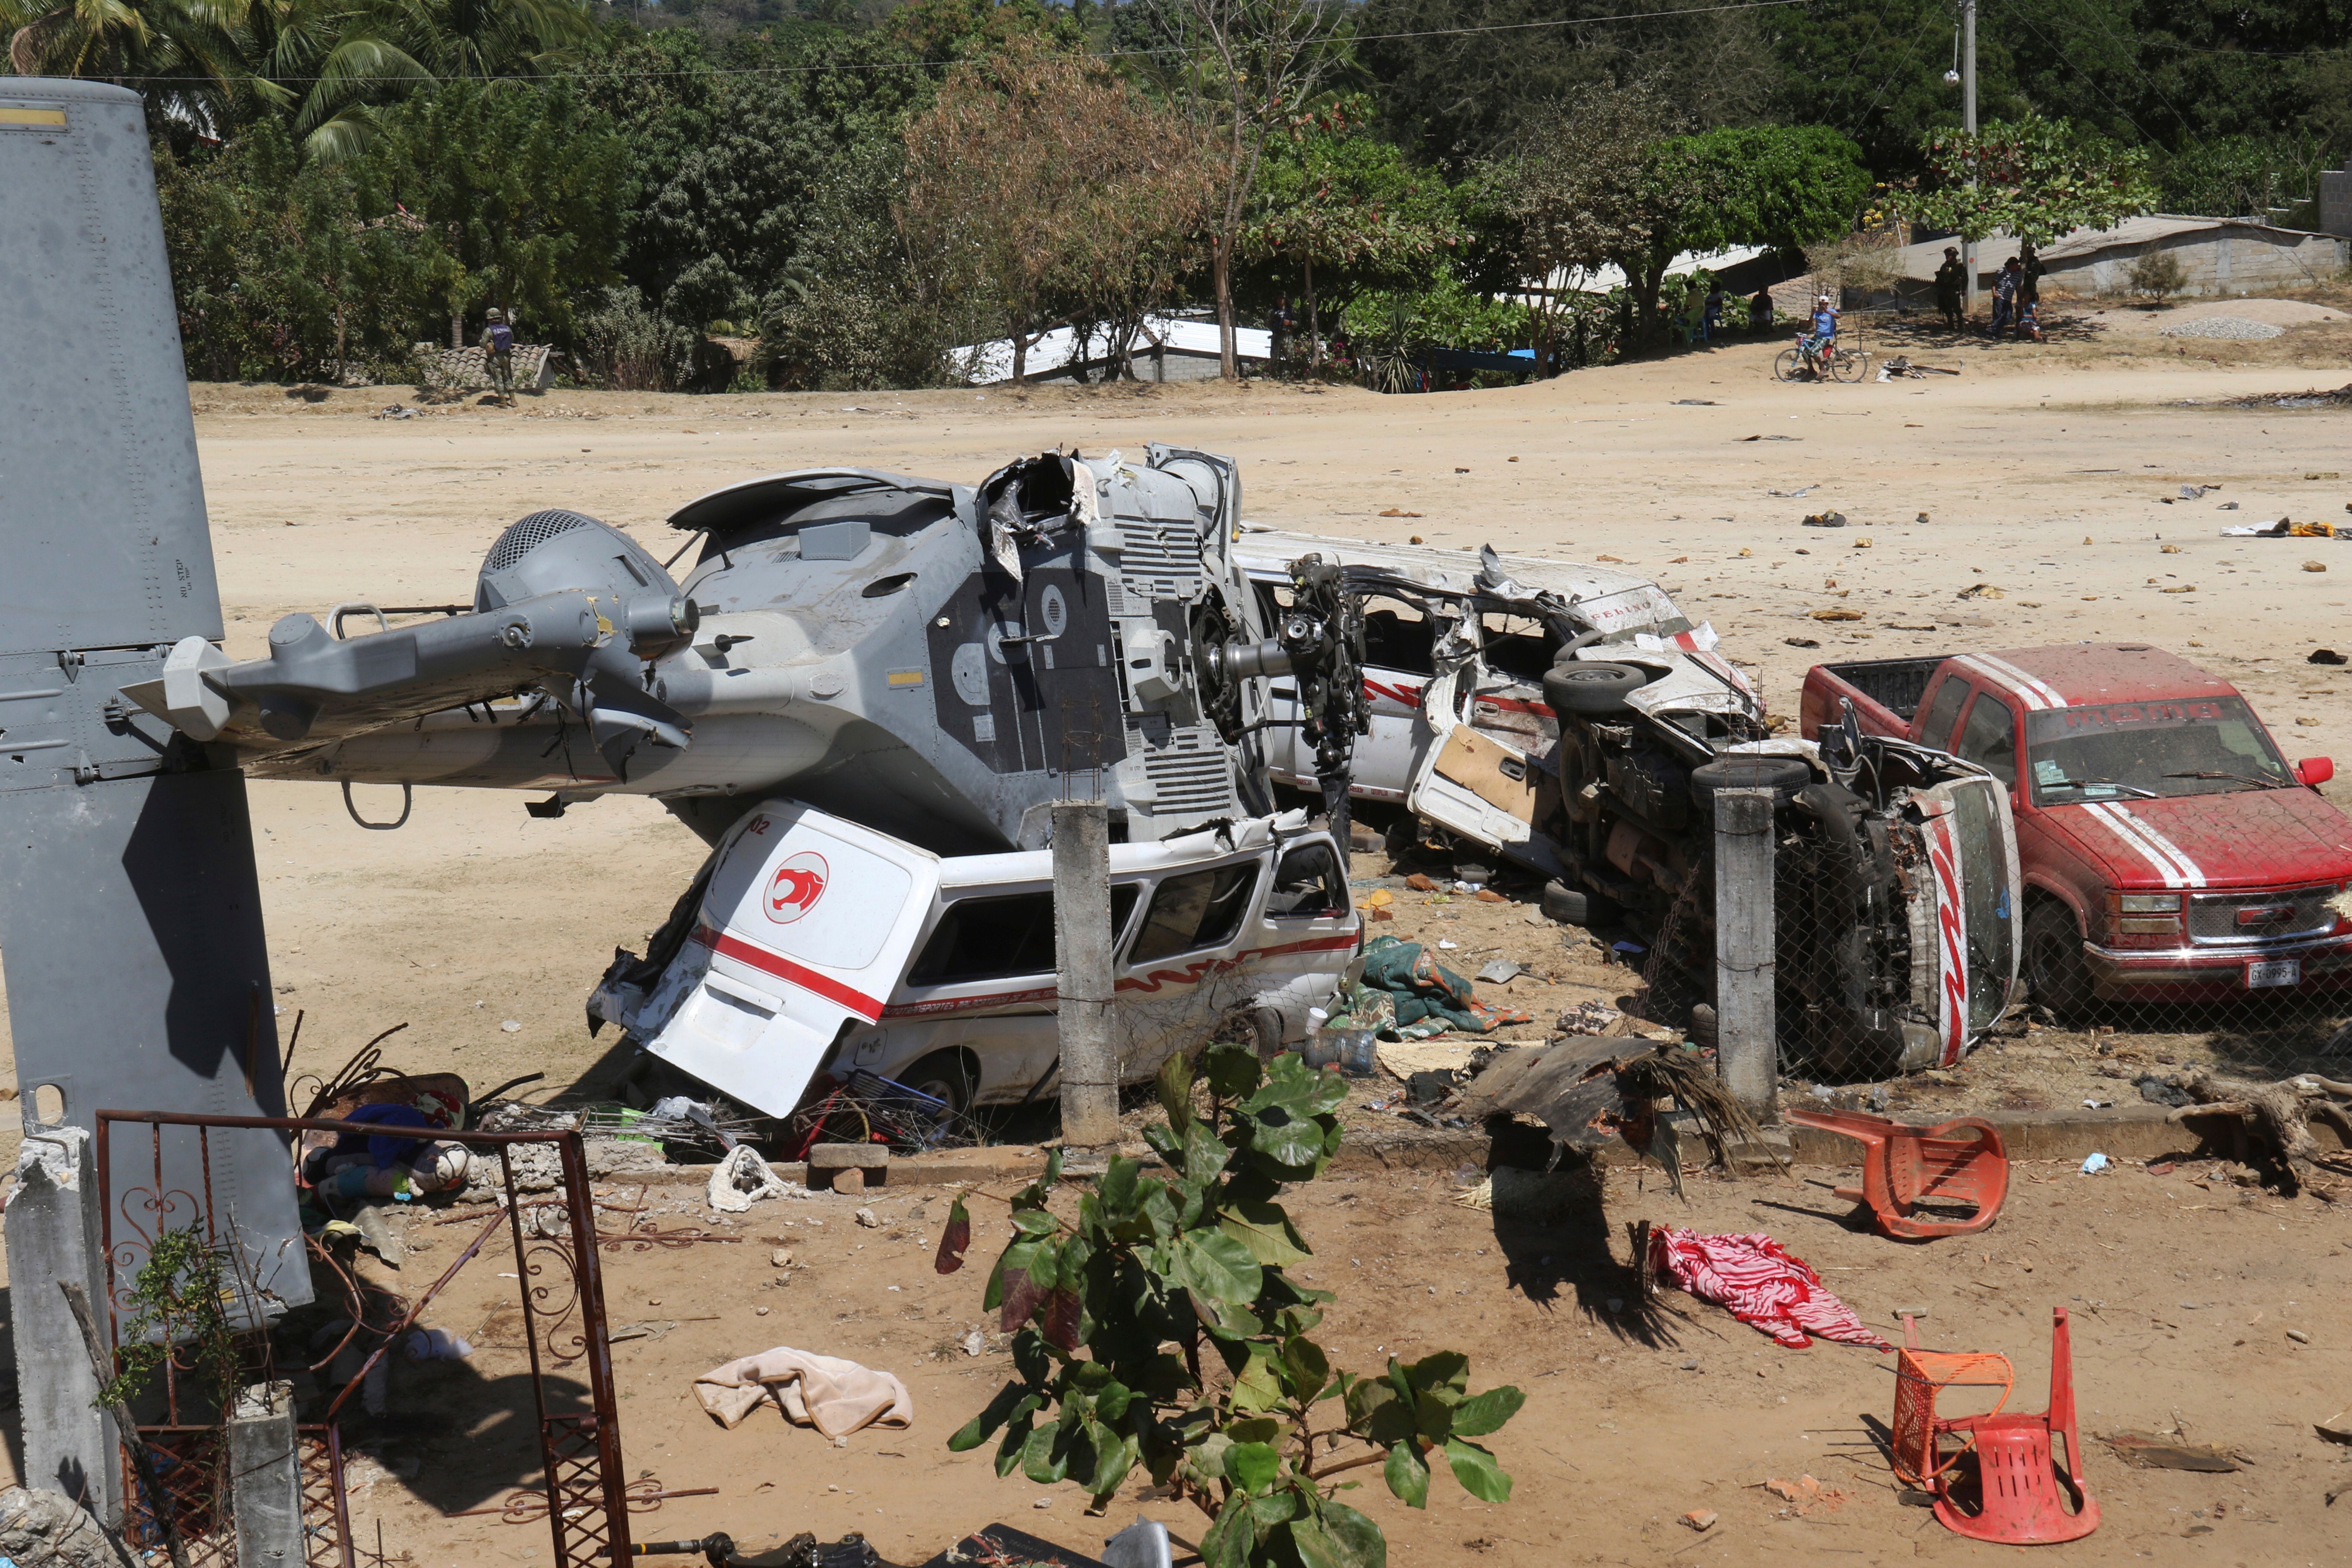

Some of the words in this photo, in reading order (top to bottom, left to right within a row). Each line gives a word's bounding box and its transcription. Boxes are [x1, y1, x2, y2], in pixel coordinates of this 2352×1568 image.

[176, 559, 184, 581] STEP
[180, 586, 187, 597] NO
[1590, 601, 1651, 621] FELINO
[1371, 788, 1388, 796] CATERPILLAR
[2252, 967, 2297, 981] GX-0995-A
